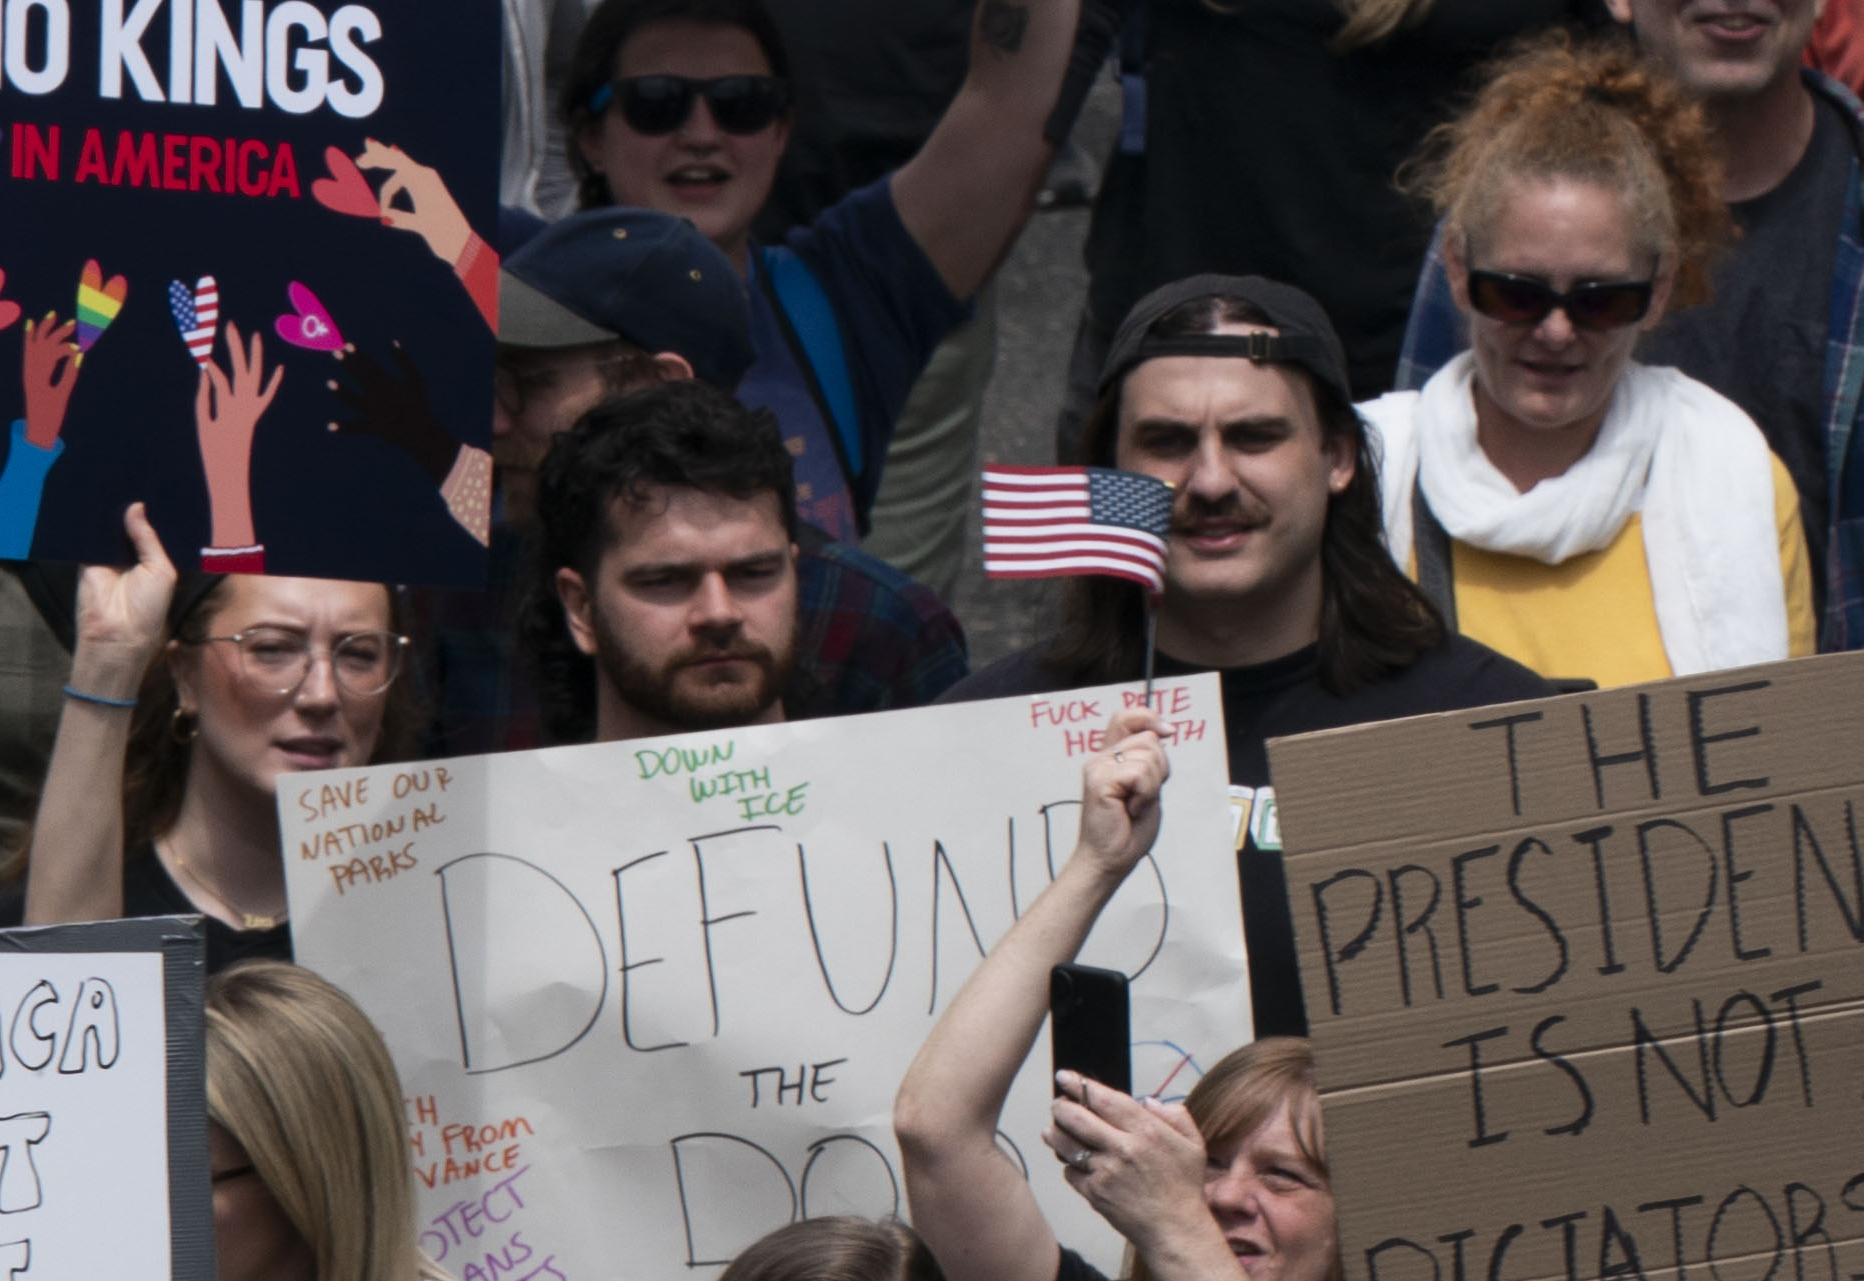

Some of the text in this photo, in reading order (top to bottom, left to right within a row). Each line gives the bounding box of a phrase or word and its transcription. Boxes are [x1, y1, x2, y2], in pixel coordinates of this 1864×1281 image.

[98, 0, 386, 119] KINGS
[10, 121, 301, 199] IN AMERICA
[1030, 700, 1102, 728] FUCK
[1065, 719, 1206, 757] HETH
[634, 740, 735, 780] DOWN
[1468, 680, 1772, 816] THE
[299, 768, 453, 823] SAVE OUR
[690, 766, 771, 803] WITH
[737, 781, 809, 821] ICE
[300, 802, 447, 861] NATIONAL
[329, 842, 417, 896] PARKS
[739, 1058, 848, 1108] THE
[1441, 981, 1824, 1149] IS NOT
[442, 1116, 533, 1154] FROM
